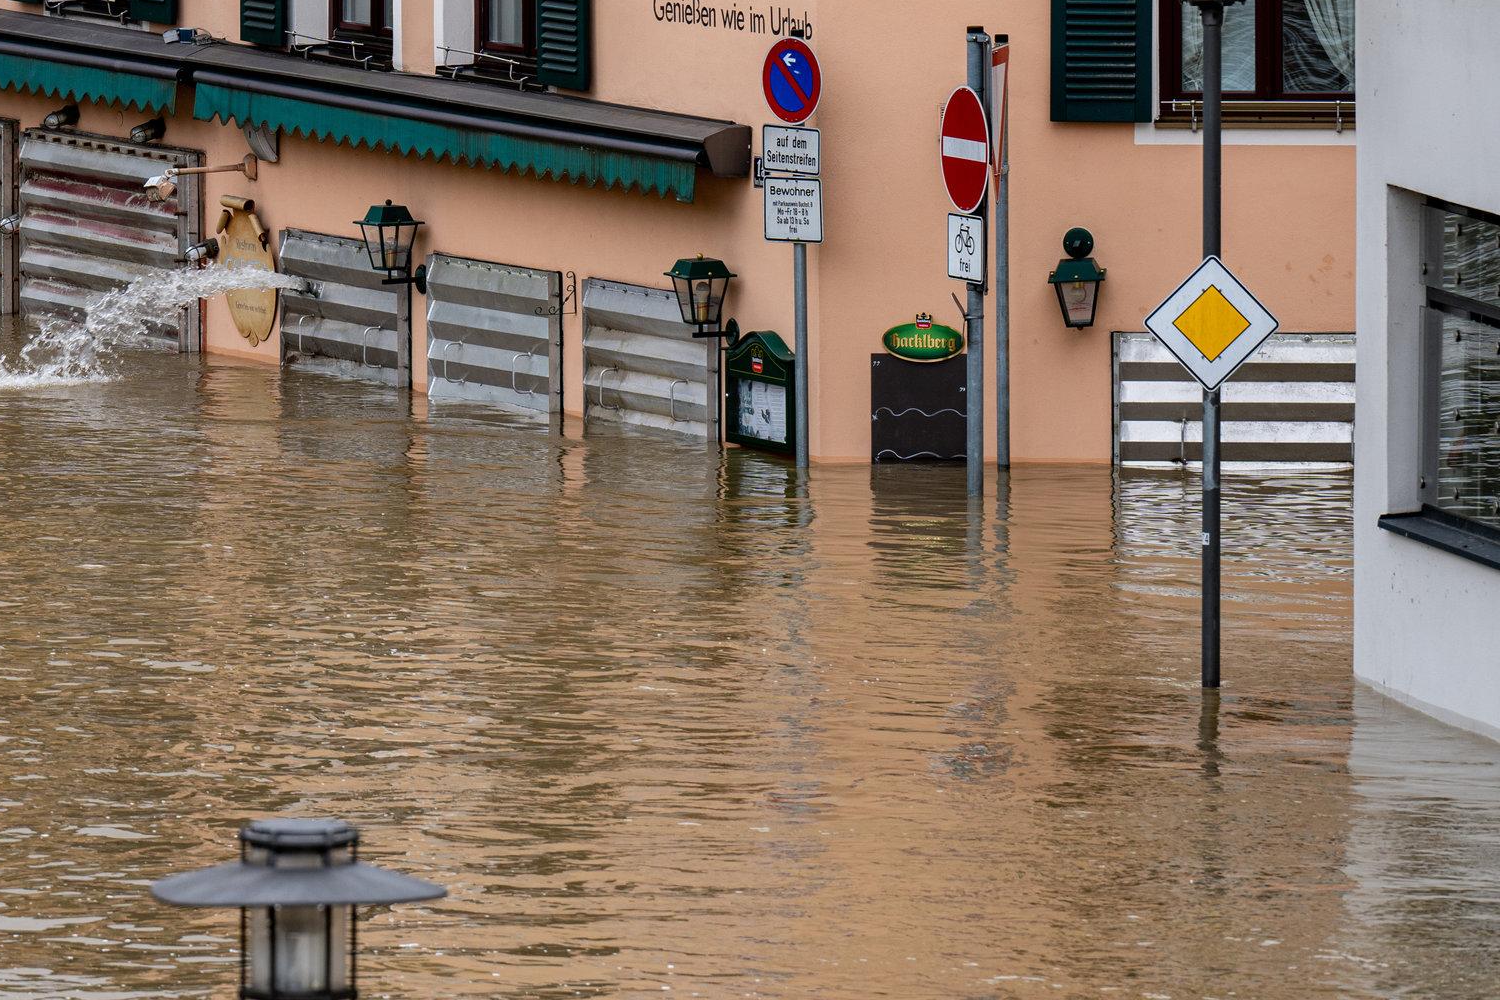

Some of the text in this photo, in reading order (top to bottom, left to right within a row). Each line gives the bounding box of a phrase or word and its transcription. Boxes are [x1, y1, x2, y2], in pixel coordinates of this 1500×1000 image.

[721, 3, 744, 30] wie
[750, 4, 765, 35] im
[776, 135, 807, 149] auf dem
[766, 150, 816, 167] Seitenstreifen
[770, 186, 815, 197] Bewohner
[959, 257, 971, 273] frei
